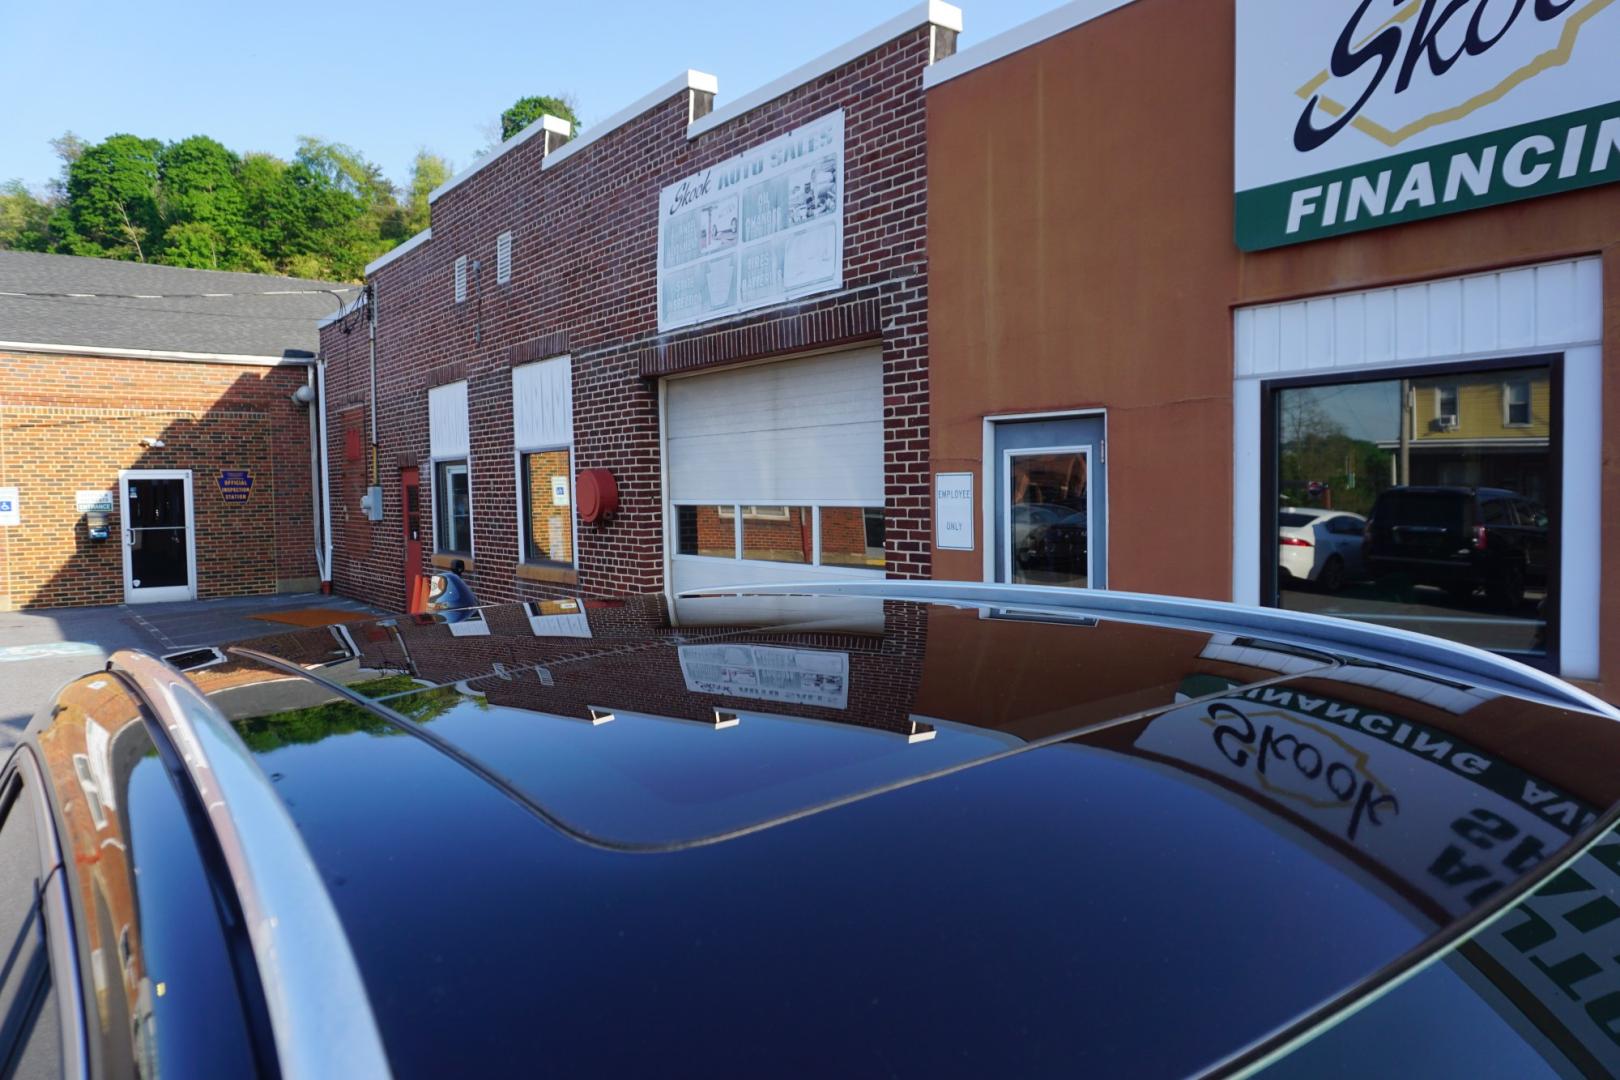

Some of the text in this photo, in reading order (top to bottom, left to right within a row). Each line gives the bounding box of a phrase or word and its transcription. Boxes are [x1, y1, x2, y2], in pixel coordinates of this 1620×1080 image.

[669, 126, 833, 216] Skook AUTO SALES
[938, 489, 971, 499] EMPLOYEE
[946, 521, 962, 531] ONLY
